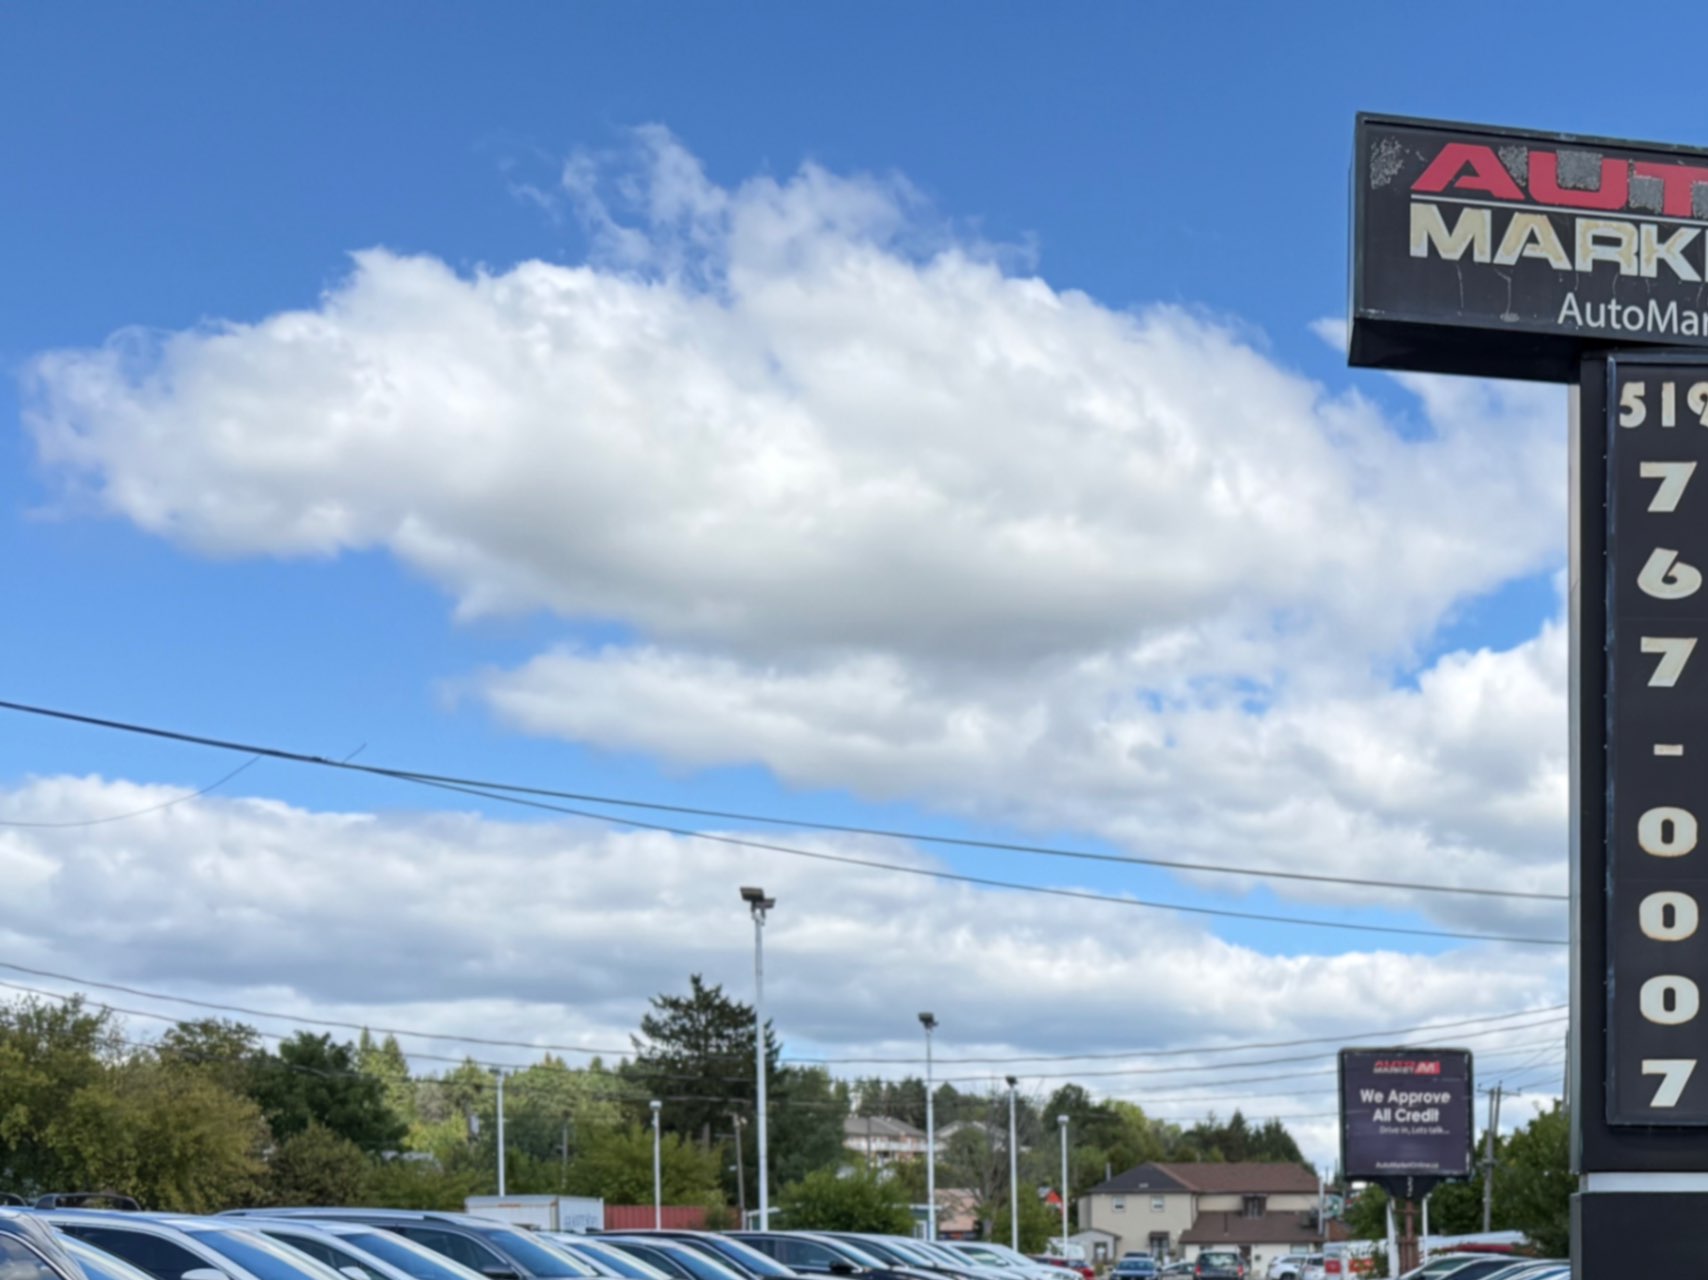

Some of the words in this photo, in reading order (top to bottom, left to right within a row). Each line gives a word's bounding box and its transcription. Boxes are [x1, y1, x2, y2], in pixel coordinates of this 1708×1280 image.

[1359, 1088, 1384, 1104] We
[1387, 1088, 1451, 1108] Approve
[1372, 1107, 1391, 1122] All
[1394, 1107, 1439, 1123] Credit
